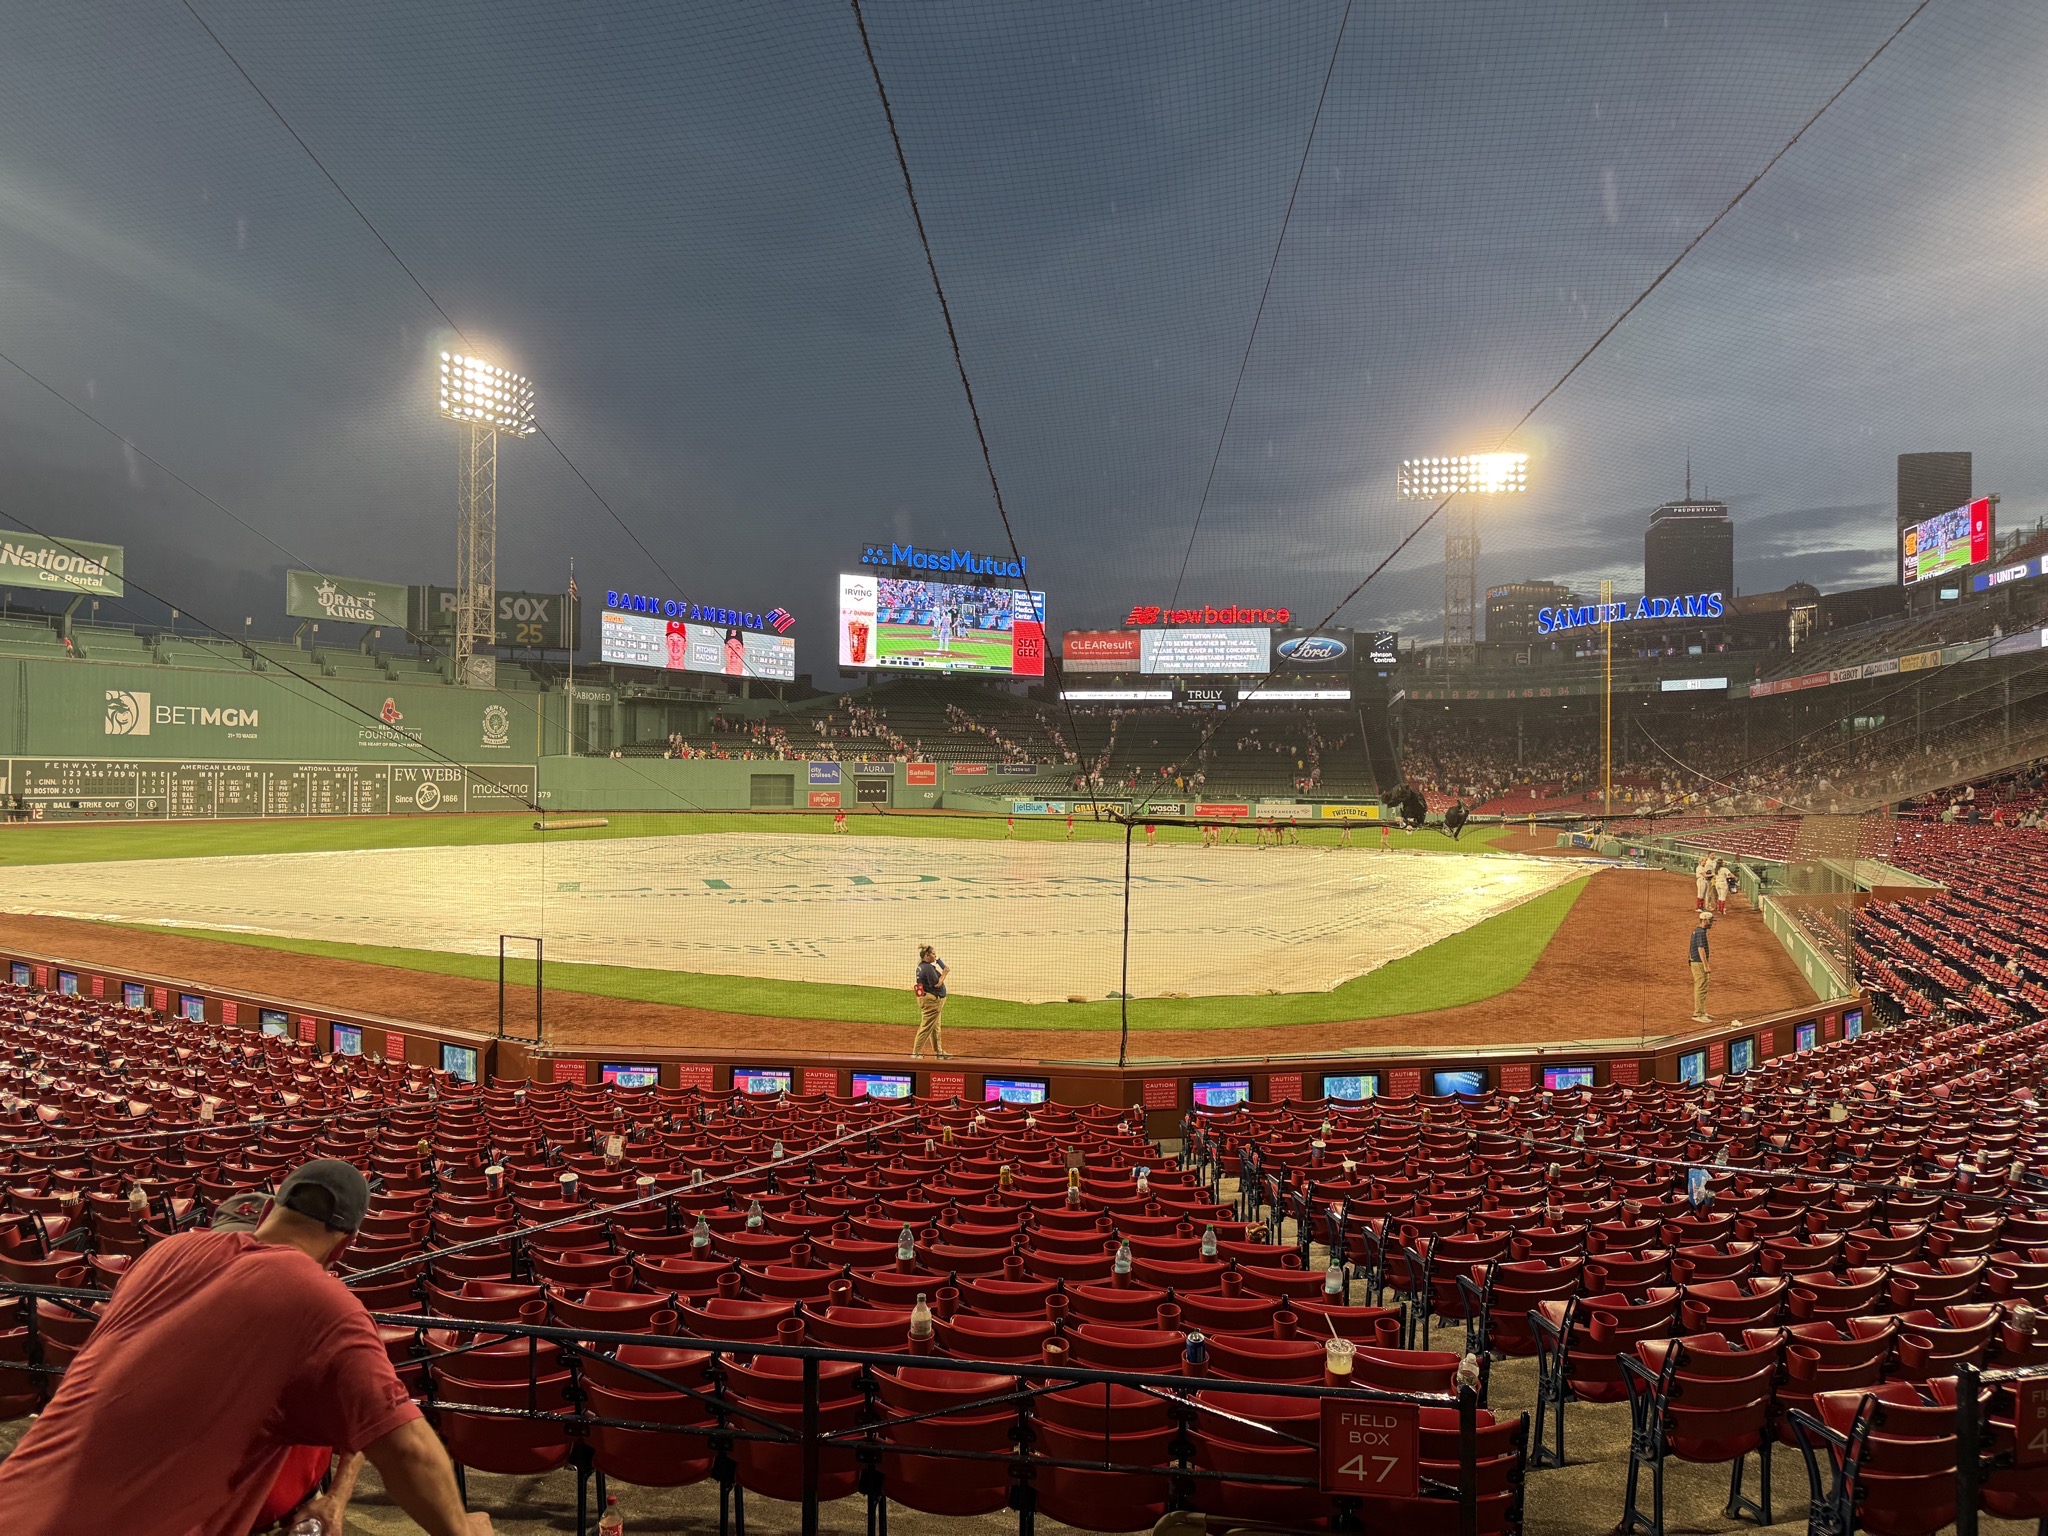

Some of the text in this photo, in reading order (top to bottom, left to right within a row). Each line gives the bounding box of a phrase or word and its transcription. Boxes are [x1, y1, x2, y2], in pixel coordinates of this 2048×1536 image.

[1, 543, 108, 576] National
[892, 543, 1026, 577] MassMutual
[39, 571, 103, 587] Car Rental
[845, 587, 872, 597] IRVING
[318, 591, 375, 609] DRAFT
[326, 605, 375, 621] KINGS
[499, 598, 549, 622] SOX
[607, 590, 764, 629] BANK OF AMERICA
[1538, 592, 1723, 635] SAMUEL ADAMS
[516, 623, 543, 643] 25
[1018, 638, 1039, 648] SEAT
[1071, 641, 1132, 650] CLEAResult
[1291, 641, 1332, 658] Ford
[1017, 647, 1039, 658] GEEK
[576, 692, 611, 701] ABIOMED
[1188, 690, 1222, 699] TRULY
[156, 705, 259, 727] BETMGM
[359, 731, 422, 741] FOUNDATION
[422, 769, 461, 781] WEBB
[811, 766, 822, 774] city
[473, 782, 528, 793] moderna
[395, 795, 413, 803] Since
[1017, 804, 1043, 812] jetBlue
[1149, 804, 1181, 812] wasabi
[1332, 808, 1368, 818] TWISTED TEA
[1341, 1413, 1398, 1428] FIELD
[1349, 1431, 1390, 1446] BOX
[1338, 1454, 1399, 1483] 47
